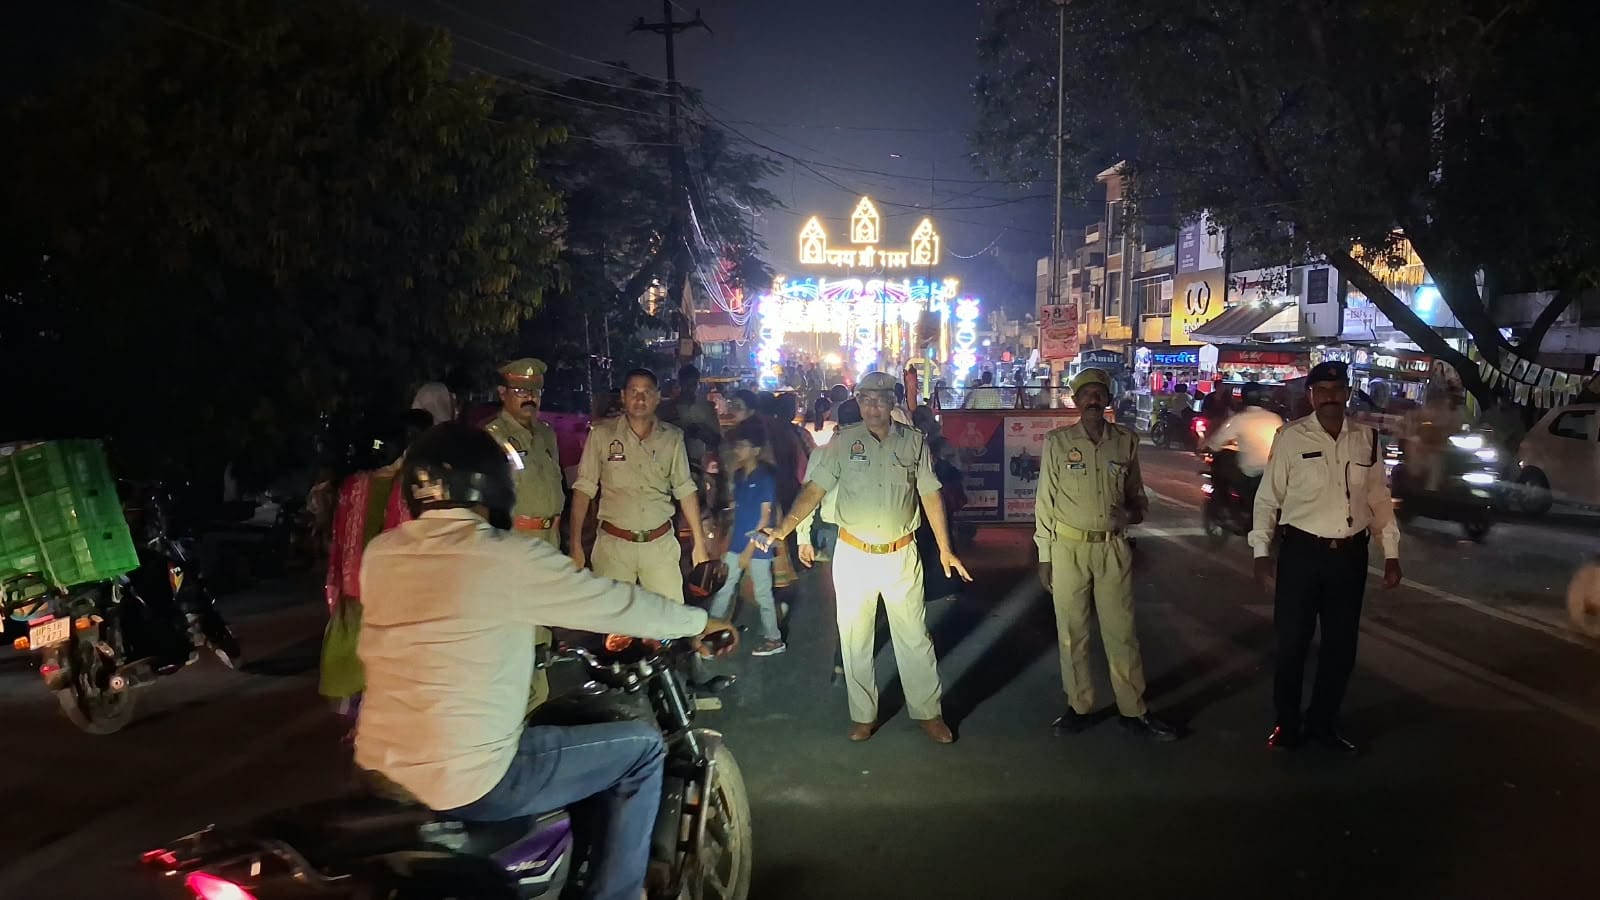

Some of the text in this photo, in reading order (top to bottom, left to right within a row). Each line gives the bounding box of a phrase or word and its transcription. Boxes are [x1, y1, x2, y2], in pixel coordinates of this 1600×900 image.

[825, 250, 856, 268] जय
[878, 250, 910, 268] राम
[1087, 352, 1118, 363] Amul
[1154, 351, 1197, 364] महावीर
